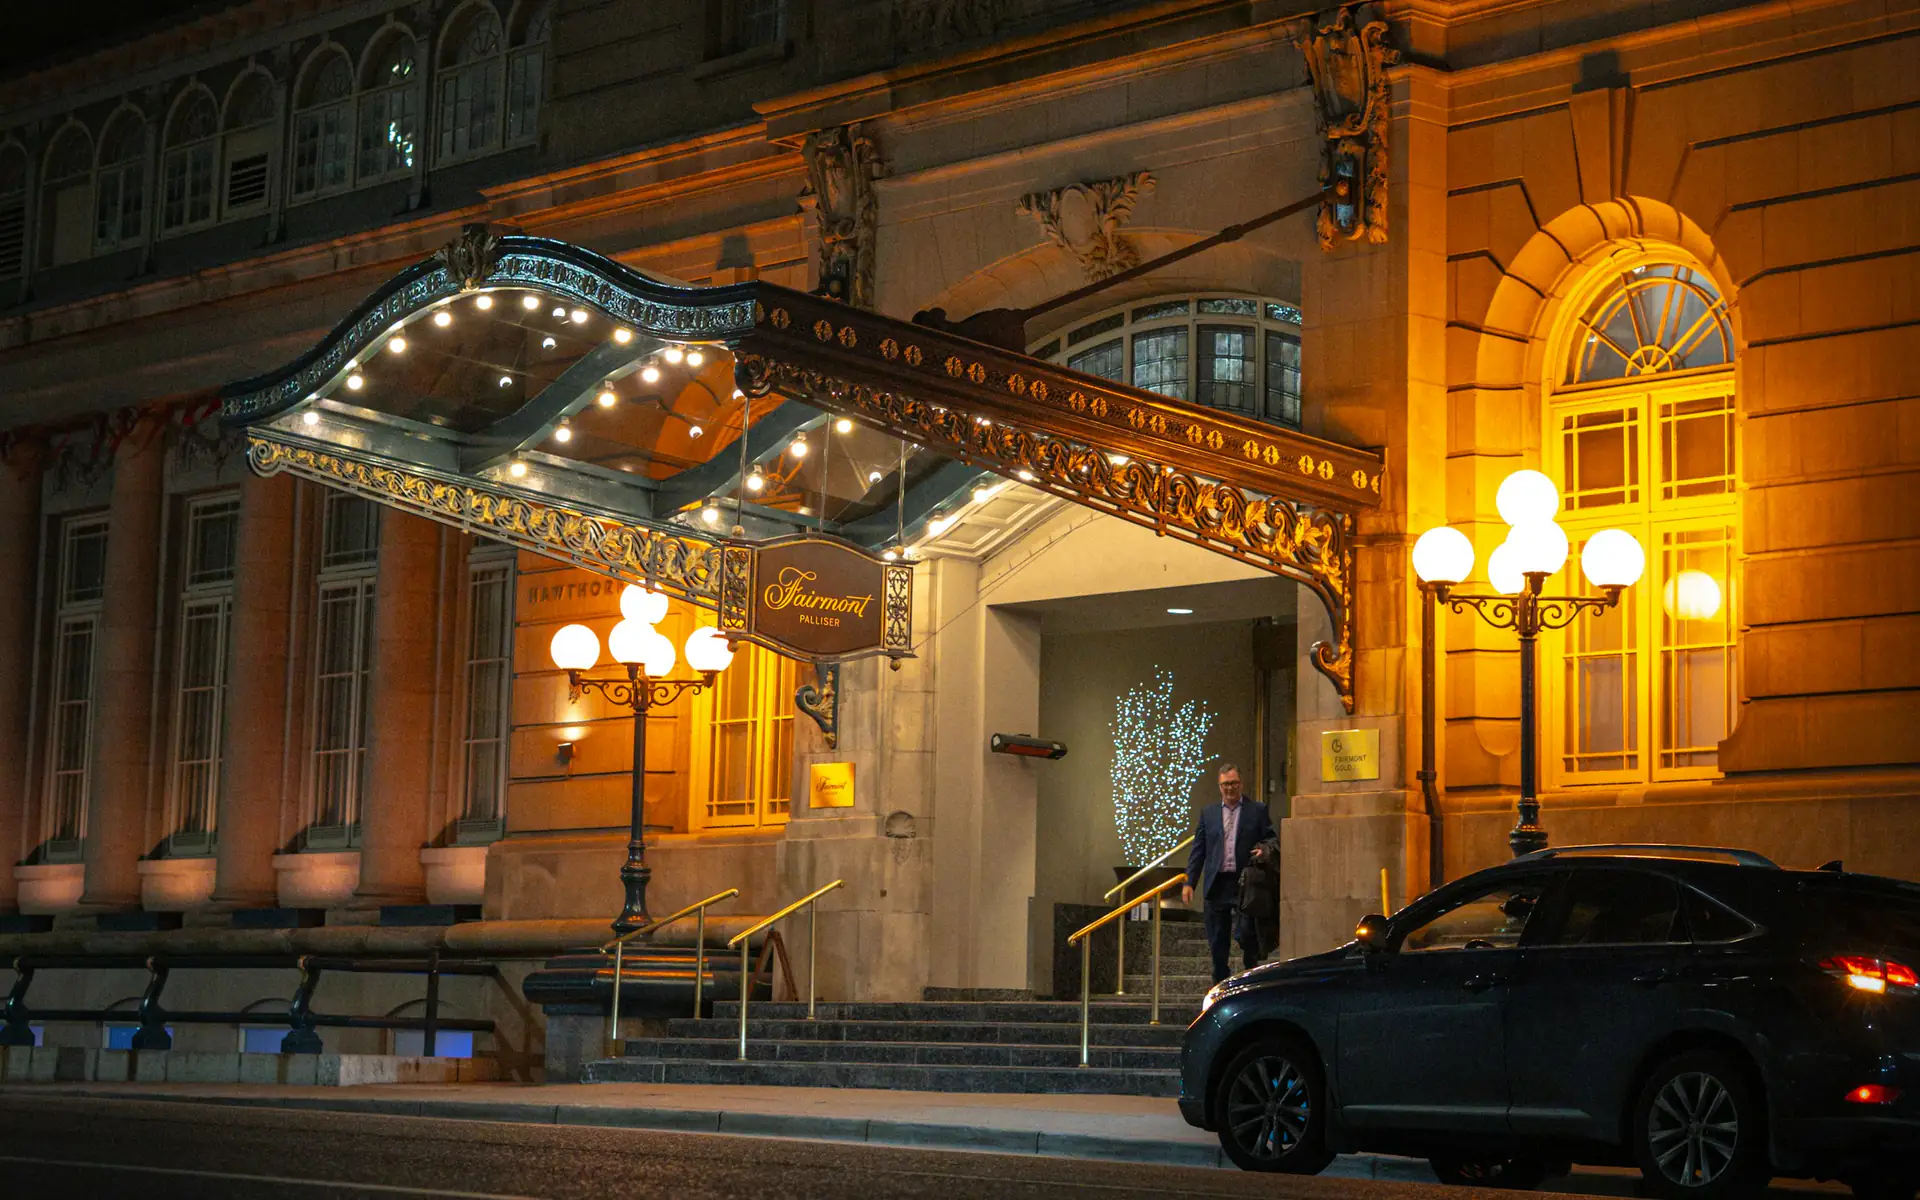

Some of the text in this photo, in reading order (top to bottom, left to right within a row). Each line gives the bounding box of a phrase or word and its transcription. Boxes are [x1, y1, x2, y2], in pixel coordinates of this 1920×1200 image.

[764, 566, 875, 617] Fairmont
[799, 614, 840, 627] PALLISER
[1334, 754, 1367, 763] FAIRMONT
[1334, 764, 1352, 772] GOLD
